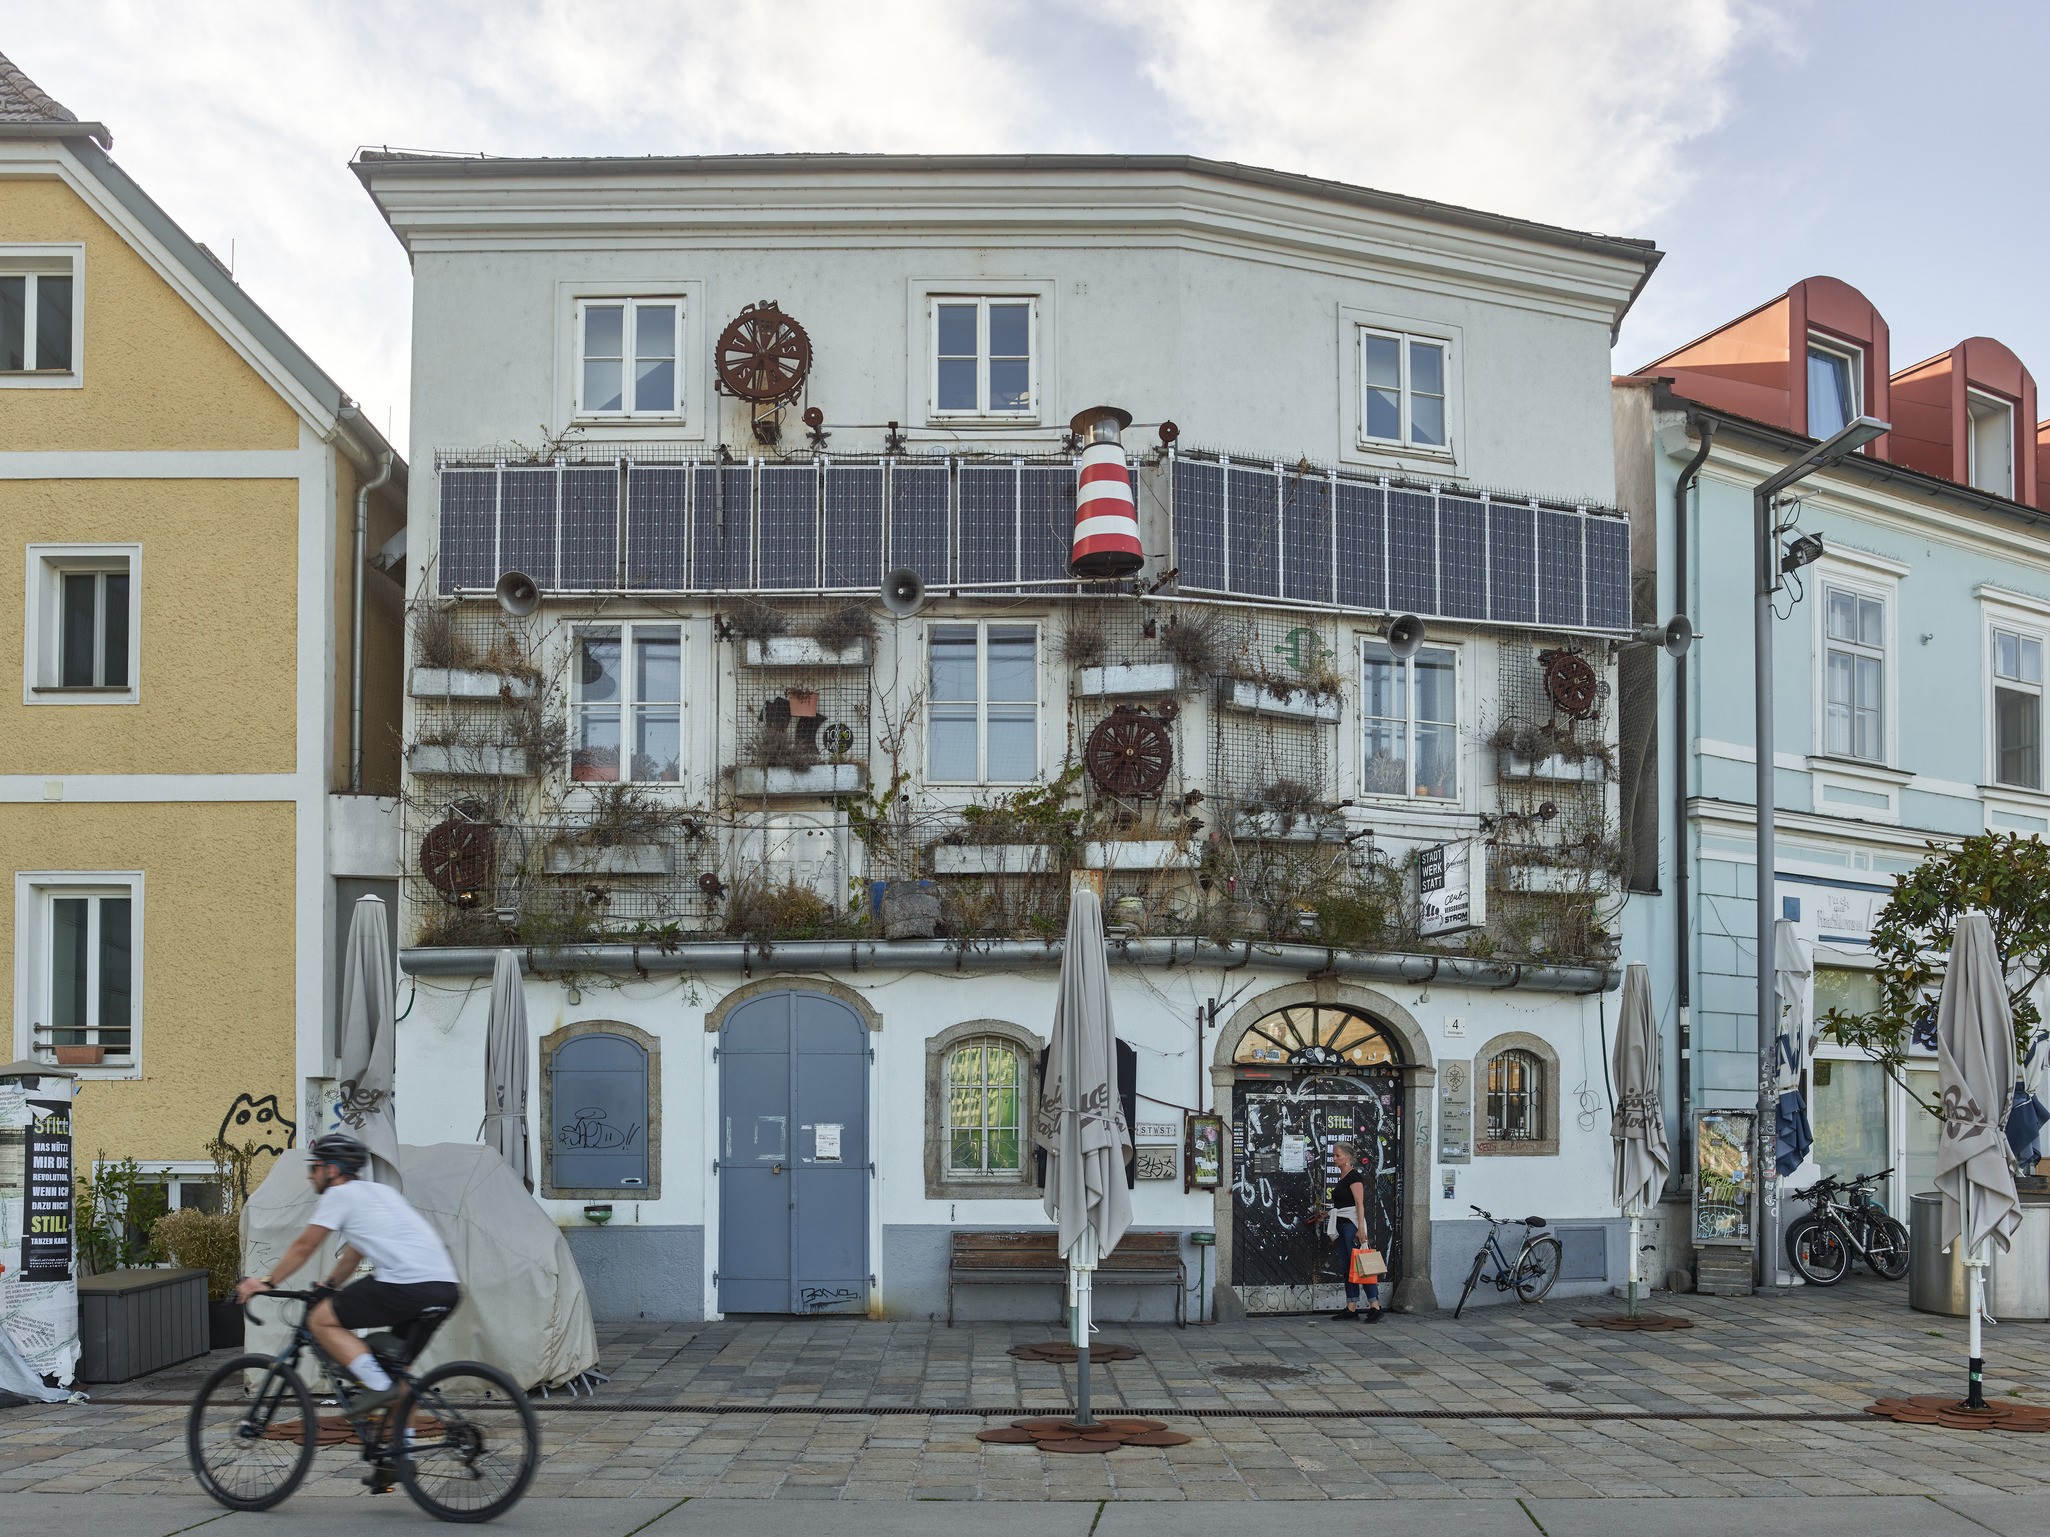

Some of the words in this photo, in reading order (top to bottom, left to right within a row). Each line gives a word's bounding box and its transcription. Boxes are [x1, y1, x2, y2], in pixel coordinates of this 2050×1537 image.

[1422, 849, 1442, 865] STADT
[1422, 861, 1443, 878] WERK
[1422, 876, 1442, 891] STATT
[1444, 891, 1468, 906] Club
[1444, 911, 1468, 924] STROM
[1452, 1019, 1459, 1030] 4
[34, 1116, 69, 1135] STILL
[1327, 1115, 1353, 1129] STILL
[1141, 1126, 1171, 1134] STWST
[33, 1142, 51, 1152] WAS
[33, 1156, 55, 1169] MIR
[56, 1156, 69, 1169] DIE
[32, 1186, 57, 1197] WENN
[31, 1201, 51, 1210] DAZU
[31, 1215, 68, 1233] STILL
[31, 1237, 53, 1245] TANZEN
